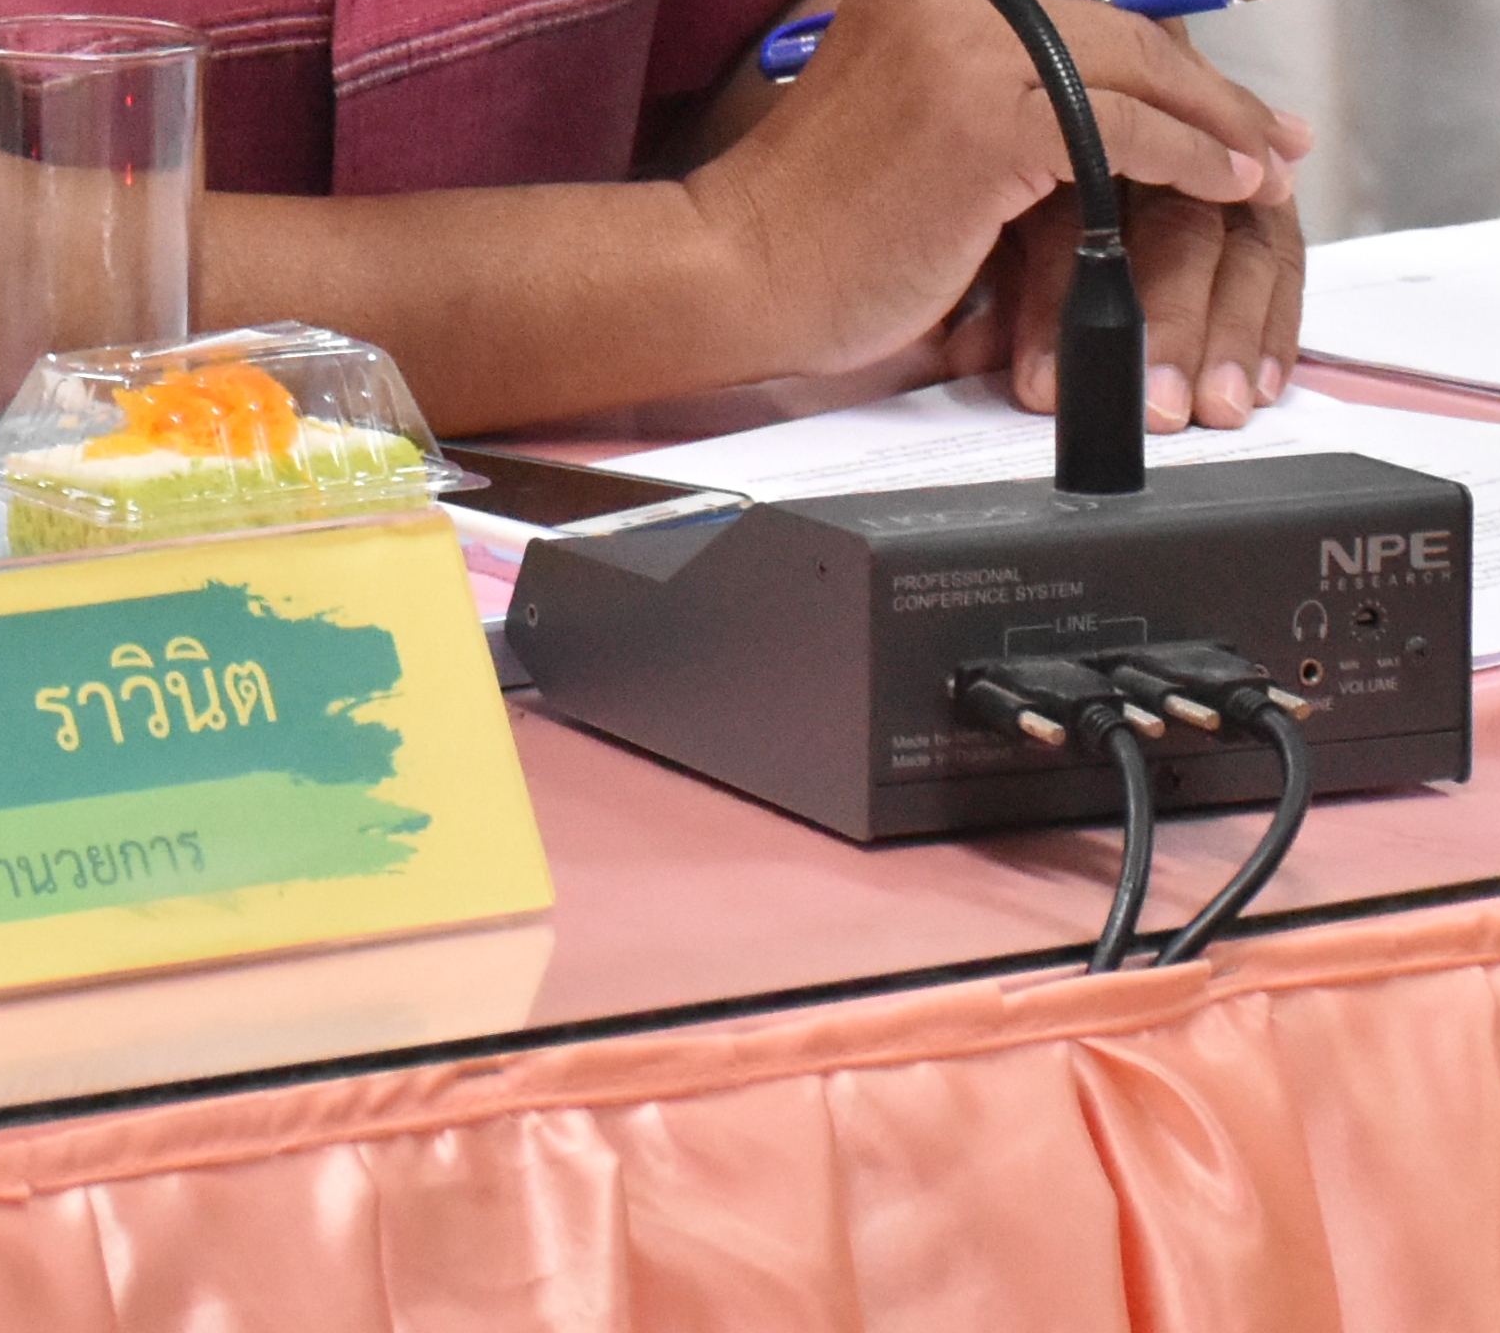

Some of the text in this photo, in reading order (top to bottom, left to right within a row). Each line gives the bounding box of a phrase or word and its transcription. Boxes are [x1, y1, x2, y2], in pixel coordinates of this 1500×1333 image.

[1320, 530, 1451, 577] NPE
[893, 567, 1021, 591] PROFESSIONAL
[1320, 570, 1451, 592] RESEARCH
[893, 581, 1084, 613] CONFERENCE SYSTEM
[1054, 612, 1100, 634] LINE
[34, 636, 278, 751] ราวินิต
[1338, 676, 1399, 695] VOLUME
